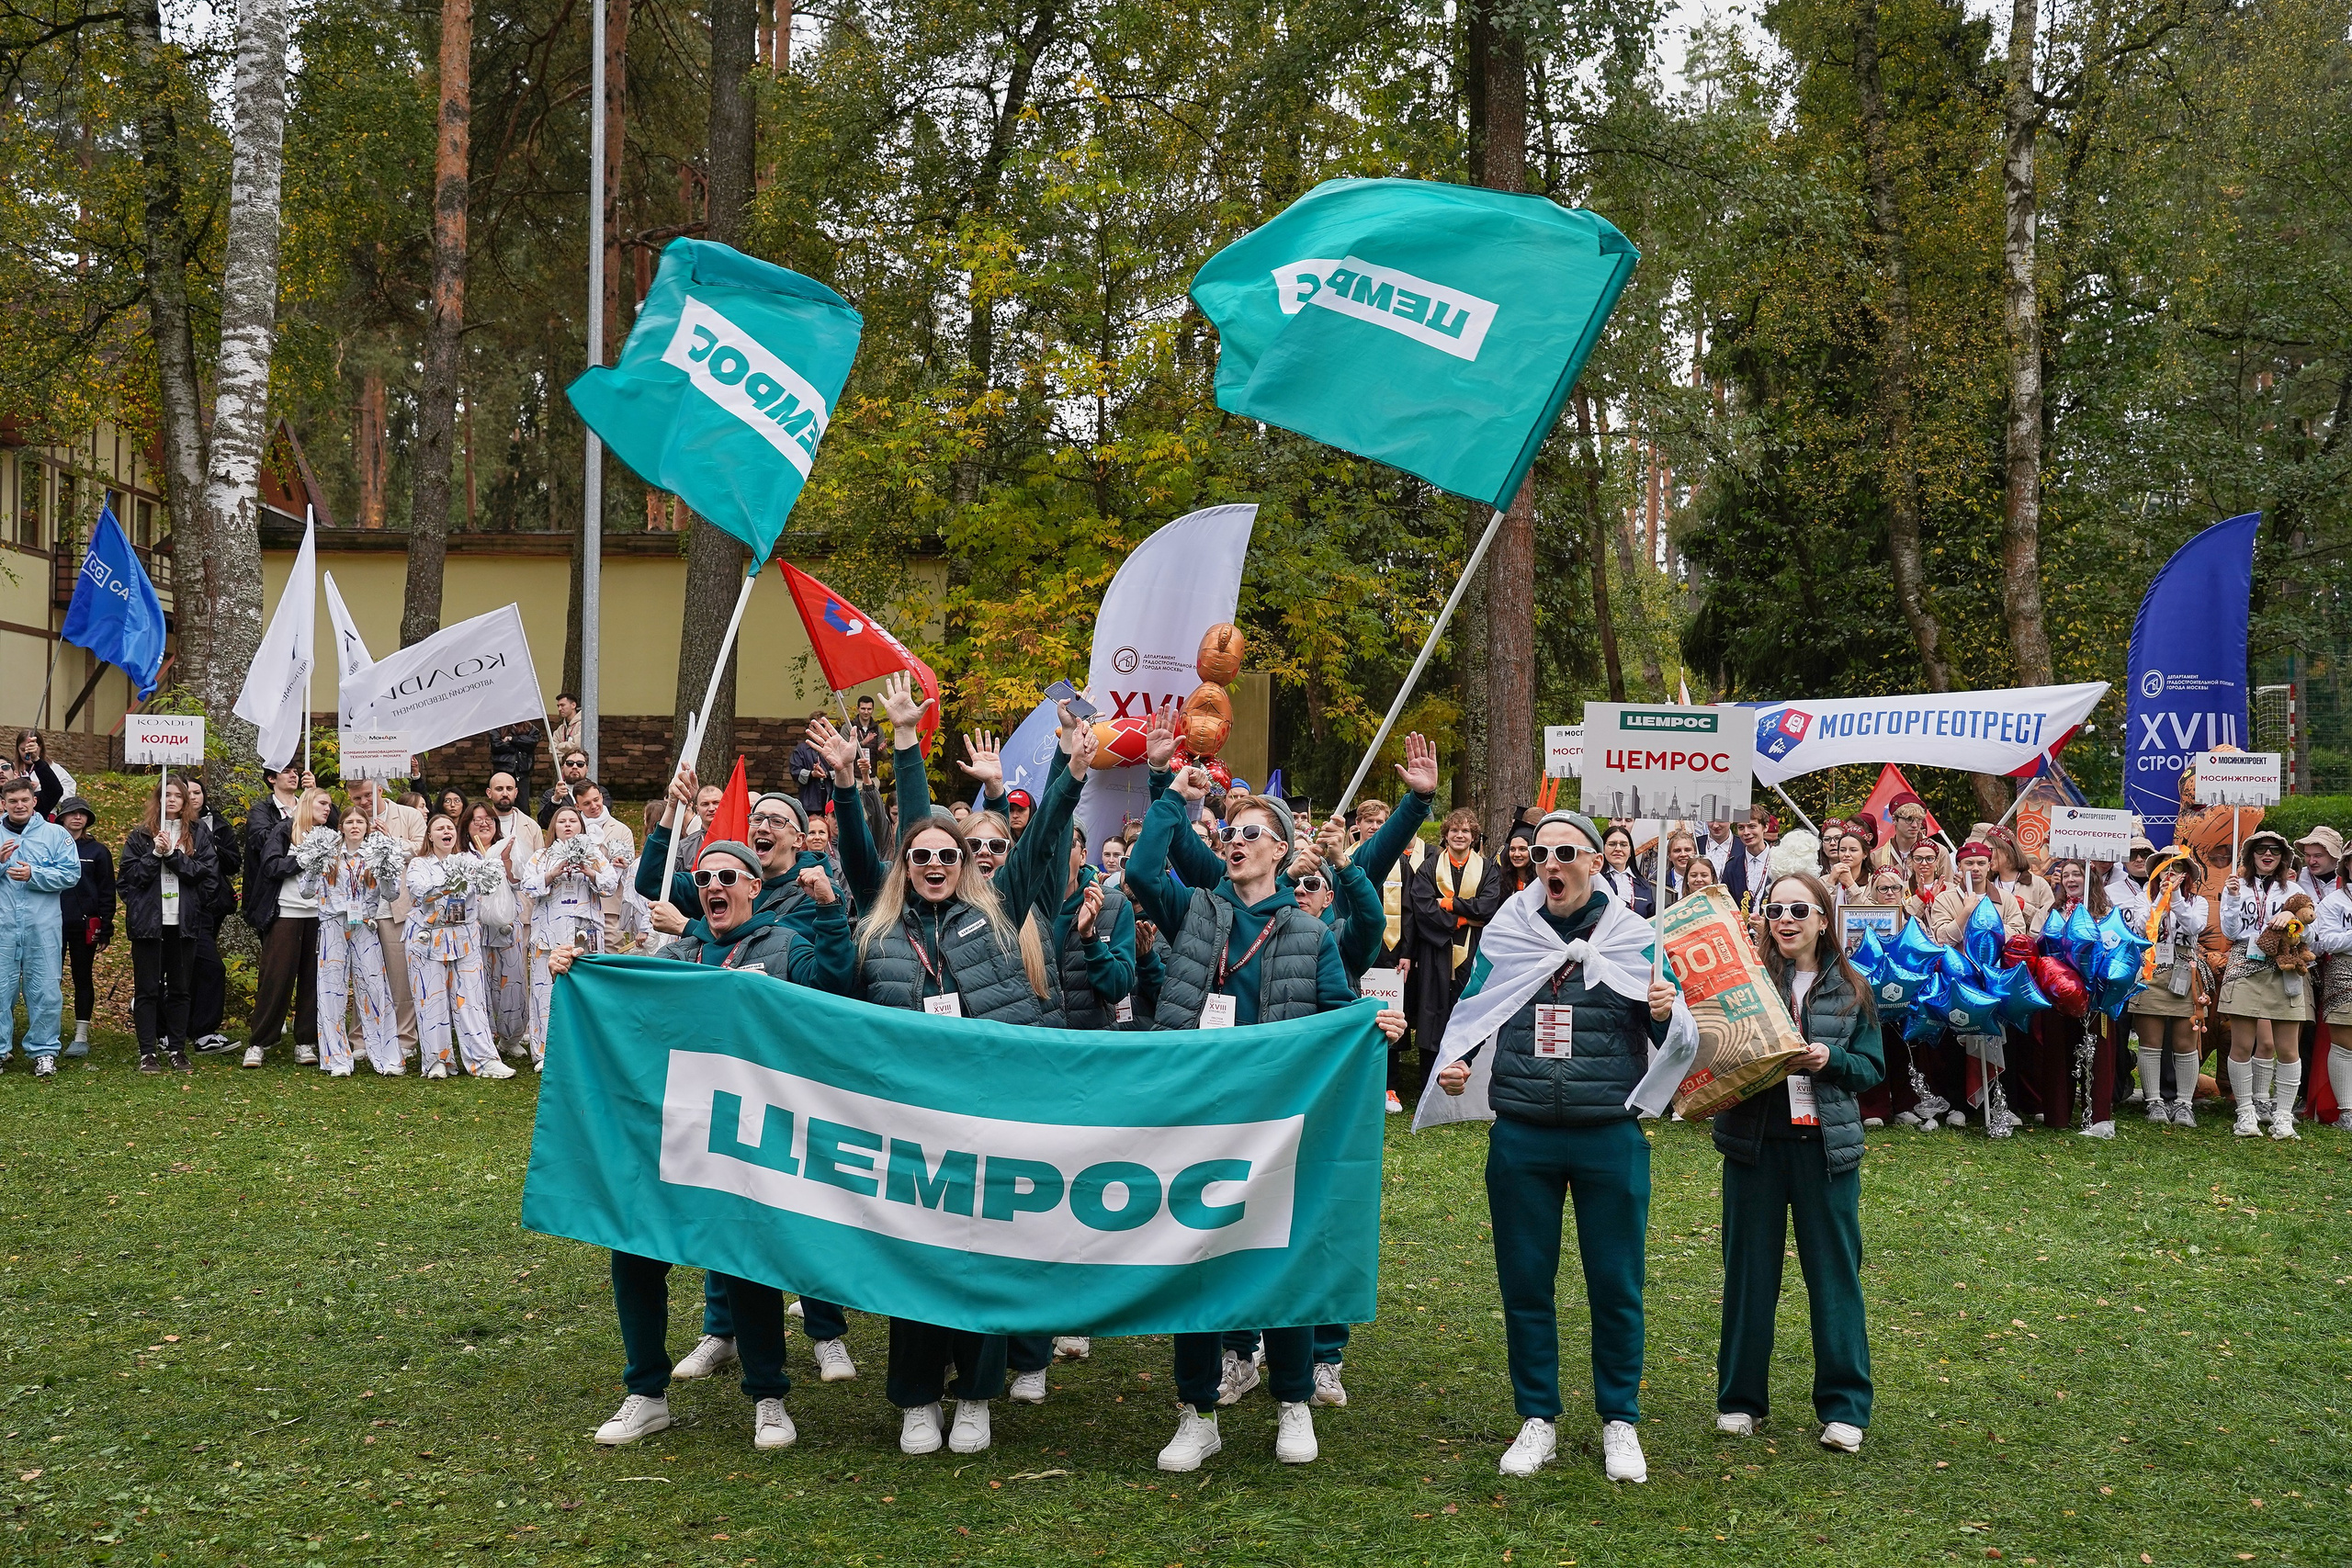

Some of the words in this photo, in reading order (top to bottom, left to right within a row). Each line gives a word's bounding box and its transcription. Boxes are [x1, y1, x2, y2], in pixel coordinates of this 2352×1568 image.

[1142, 660, 1193, 669] ГРАДОСТРОИТЕЛЬНОЙ
[1626, 715, 1711, 729] ЦЕМРОС
[1818, 710, 2047, 746] МОСГОРГЕОТРЕСТ
[2138, 712, 2237, 751] XVIII
[141, 735, 188, 746] КОЛДИ
[1606, 749, 1730, 773] ЦЕМРОС
[2218, 756, 2267, 765] МОСИНЖПРОЕКТ
[2054, 829, 2128, 840] МОСГОРГЕОТРЕСТ
[1715, 937, 1732, 962] ЭКСТРА
[1724, 987, 1756, 1010] №1
[933, 1004, 952, 1013] XVIII
[1209, 1001, 1227, 1011] XVIII
[1679, 1079, 1695, 1094] 50
[707, 1089, 1253, 1233] ЦЕМРОС
